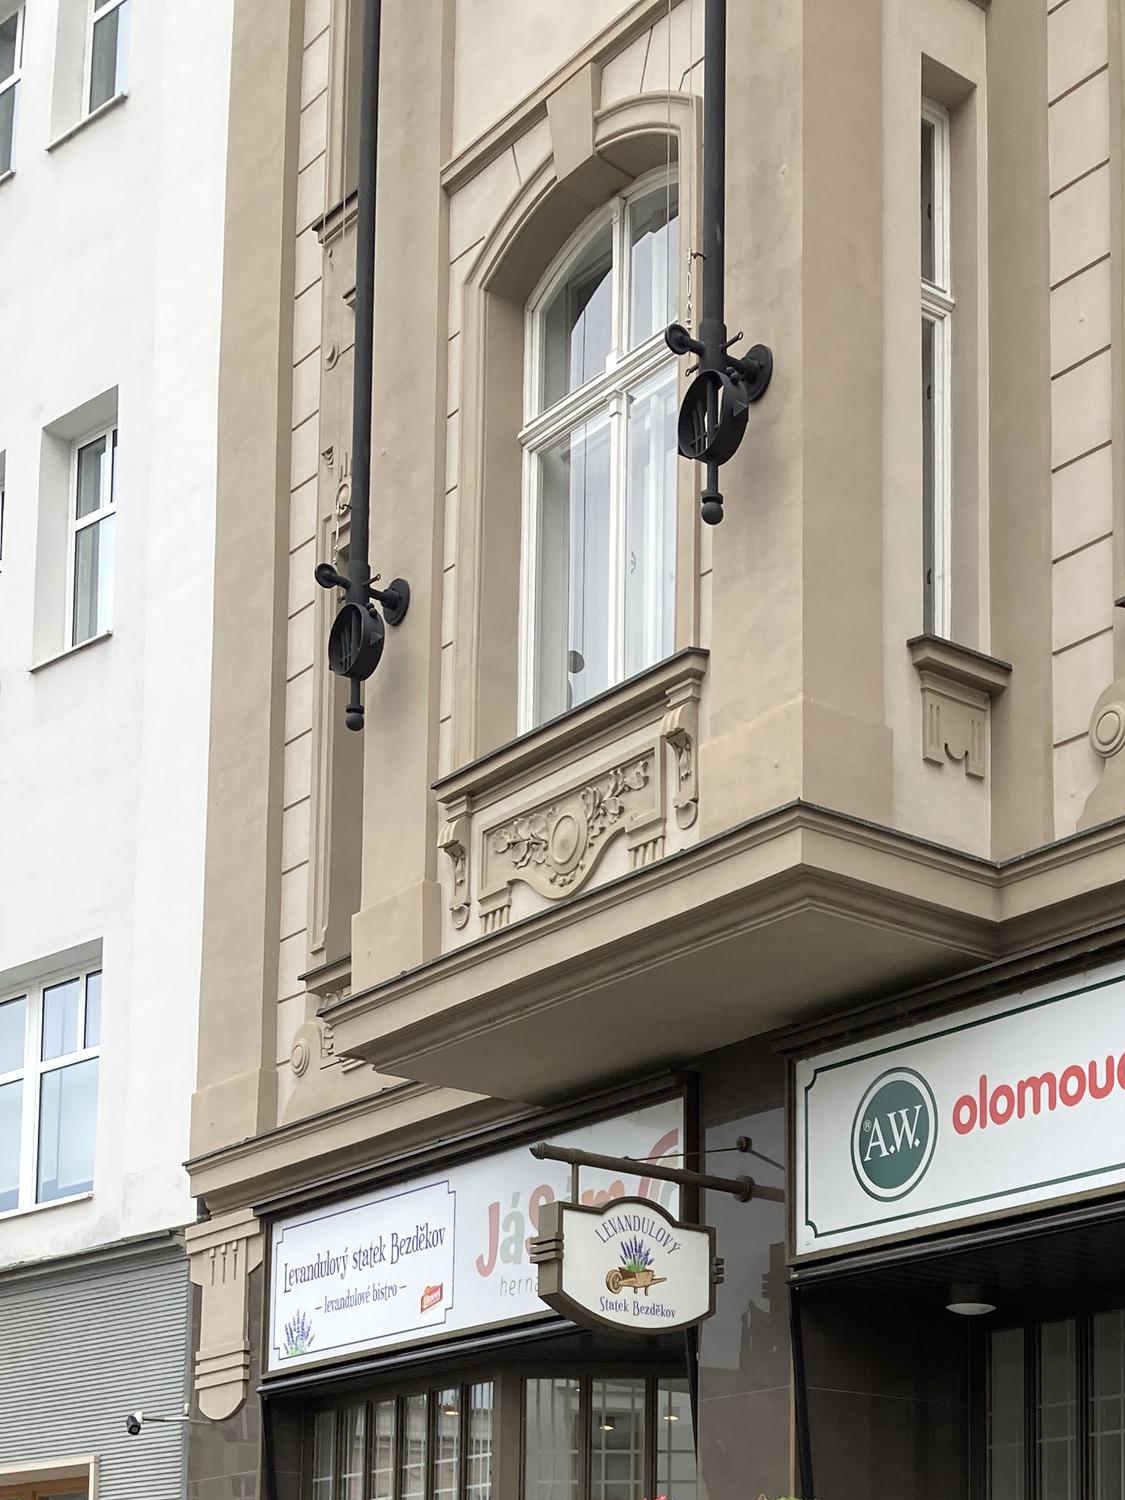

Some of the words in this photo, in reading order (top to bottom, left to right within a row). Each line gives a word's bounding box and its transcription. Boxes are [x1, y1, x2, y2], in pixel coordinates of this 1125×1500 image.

[595, 1214, 682, 1255] LEVANDULOVÝ
[284, 1247, 348, 1293] Levandulový
[352, 1236, 386, 1271] statek
[390, 1222, 446, 1265] Bezděkov
[324, 1286, 371, 1313] levandulové
[372, 1282, 397, 1302] bistro
[600, 1296, 629, 1313] Statek
[633, 1300, 676, 1319] Bezděkov
